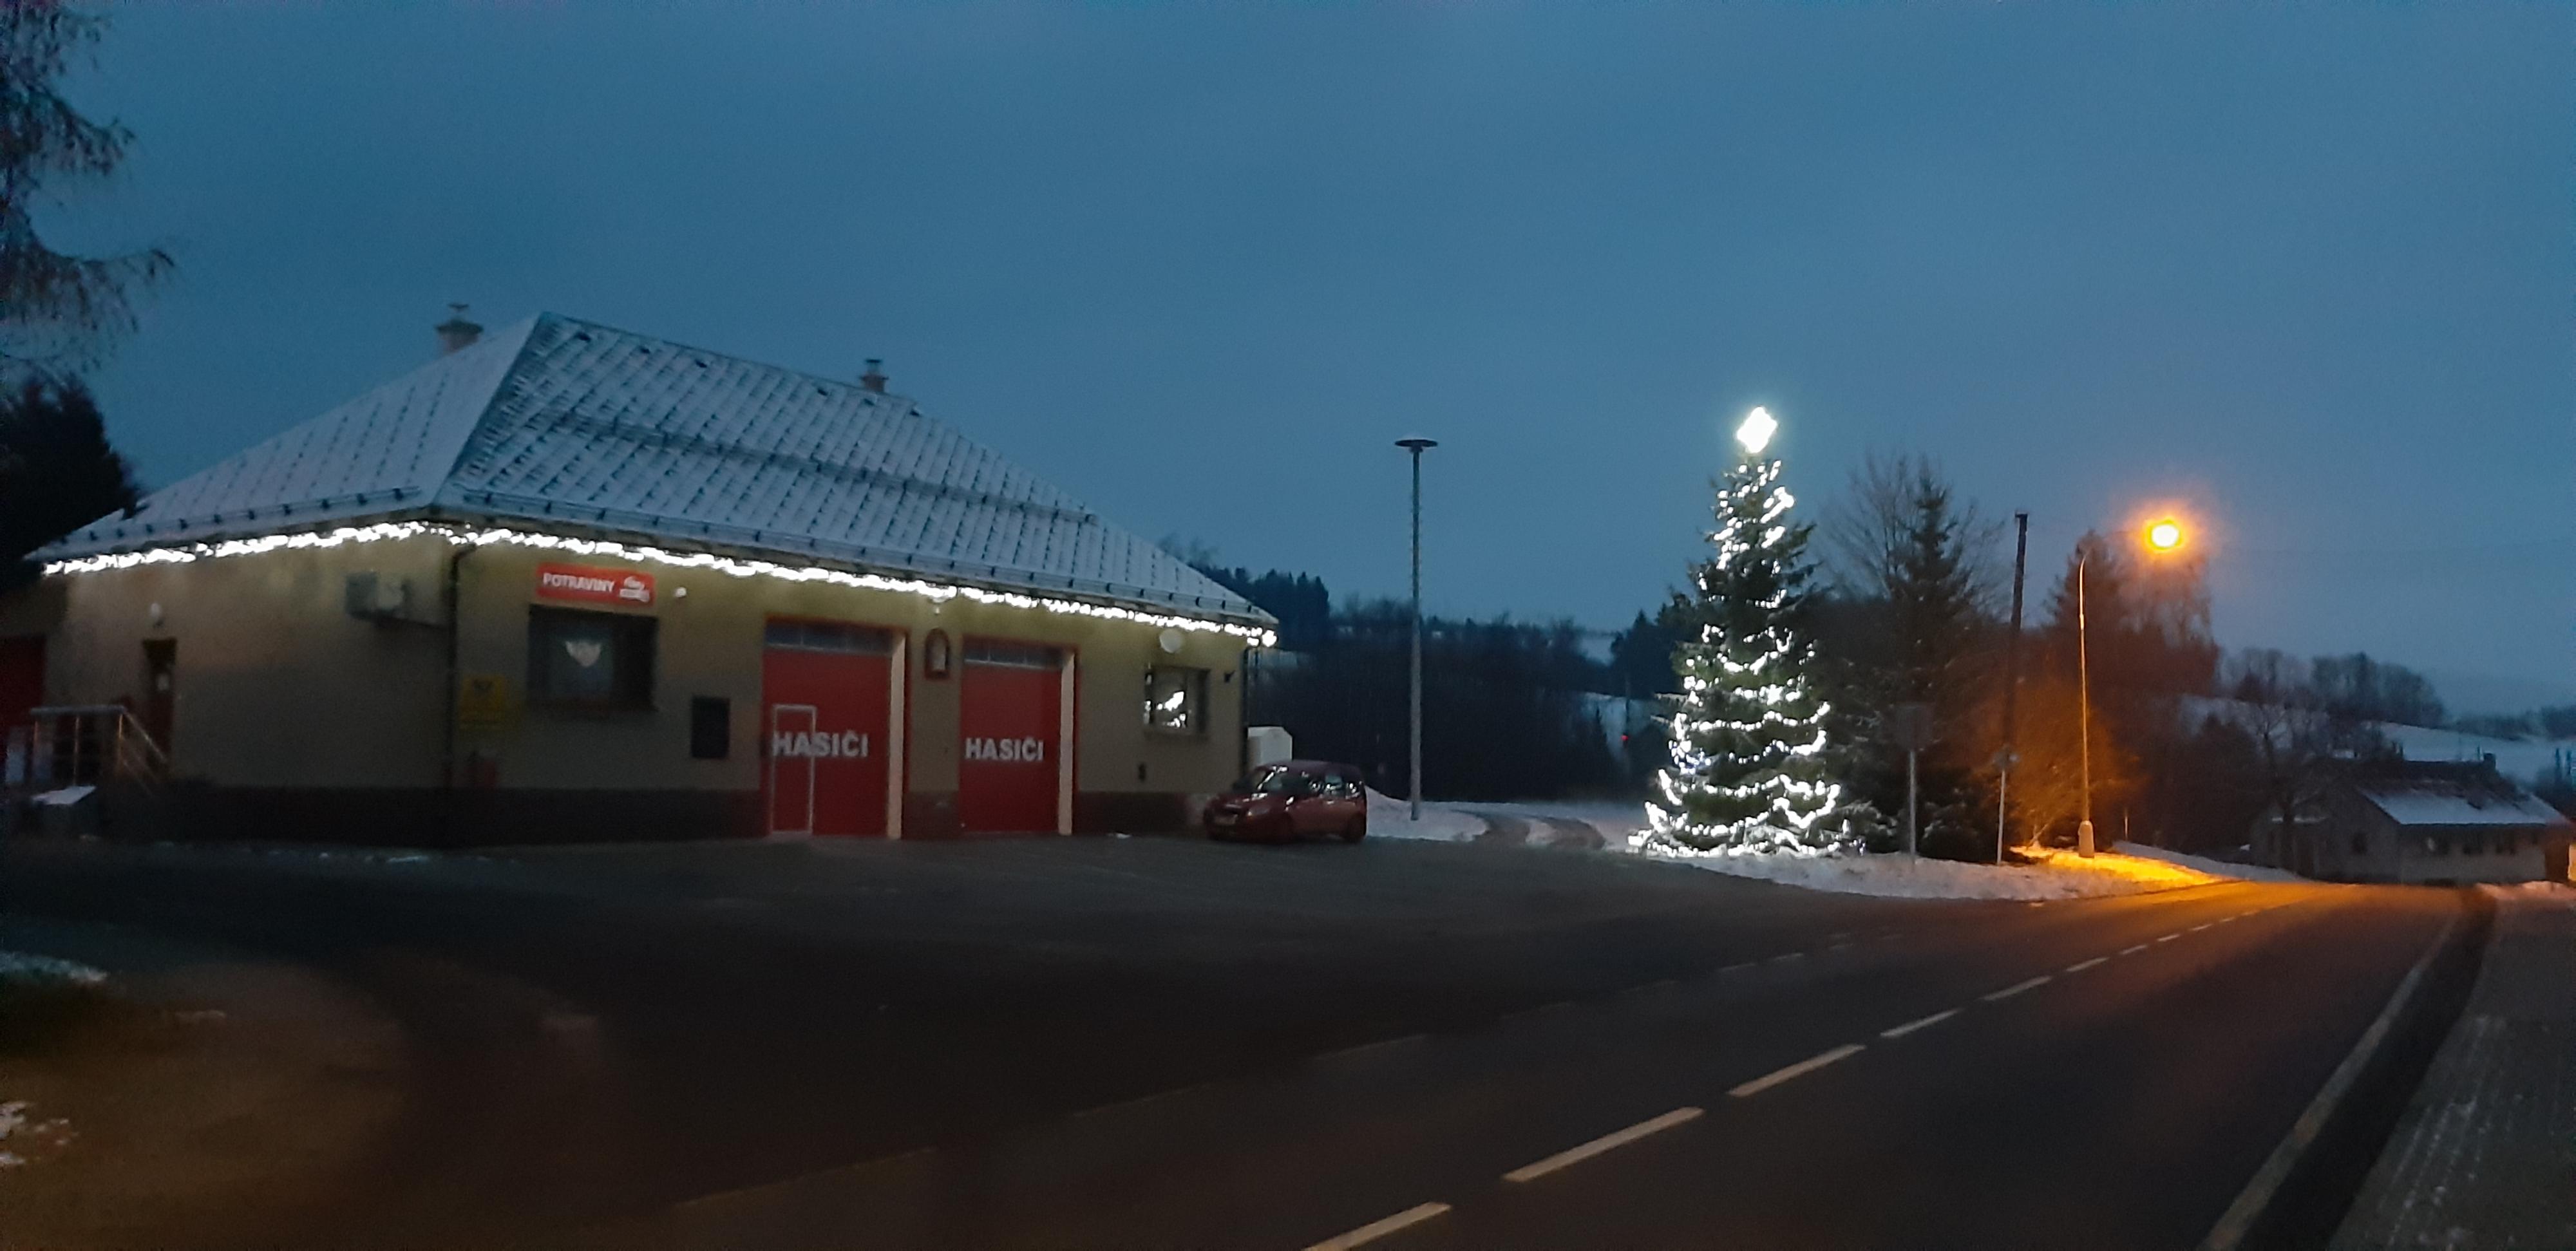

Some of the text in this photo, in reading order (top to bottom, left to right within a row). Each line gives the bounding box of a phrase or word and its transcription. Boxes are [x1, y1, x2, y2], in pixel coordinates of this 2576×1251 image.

[543, 572, 614, 592] POTRAVINY
[773, 729, 869, 757] HASIČI
[965, 735, 1044, 761] HASIČI
